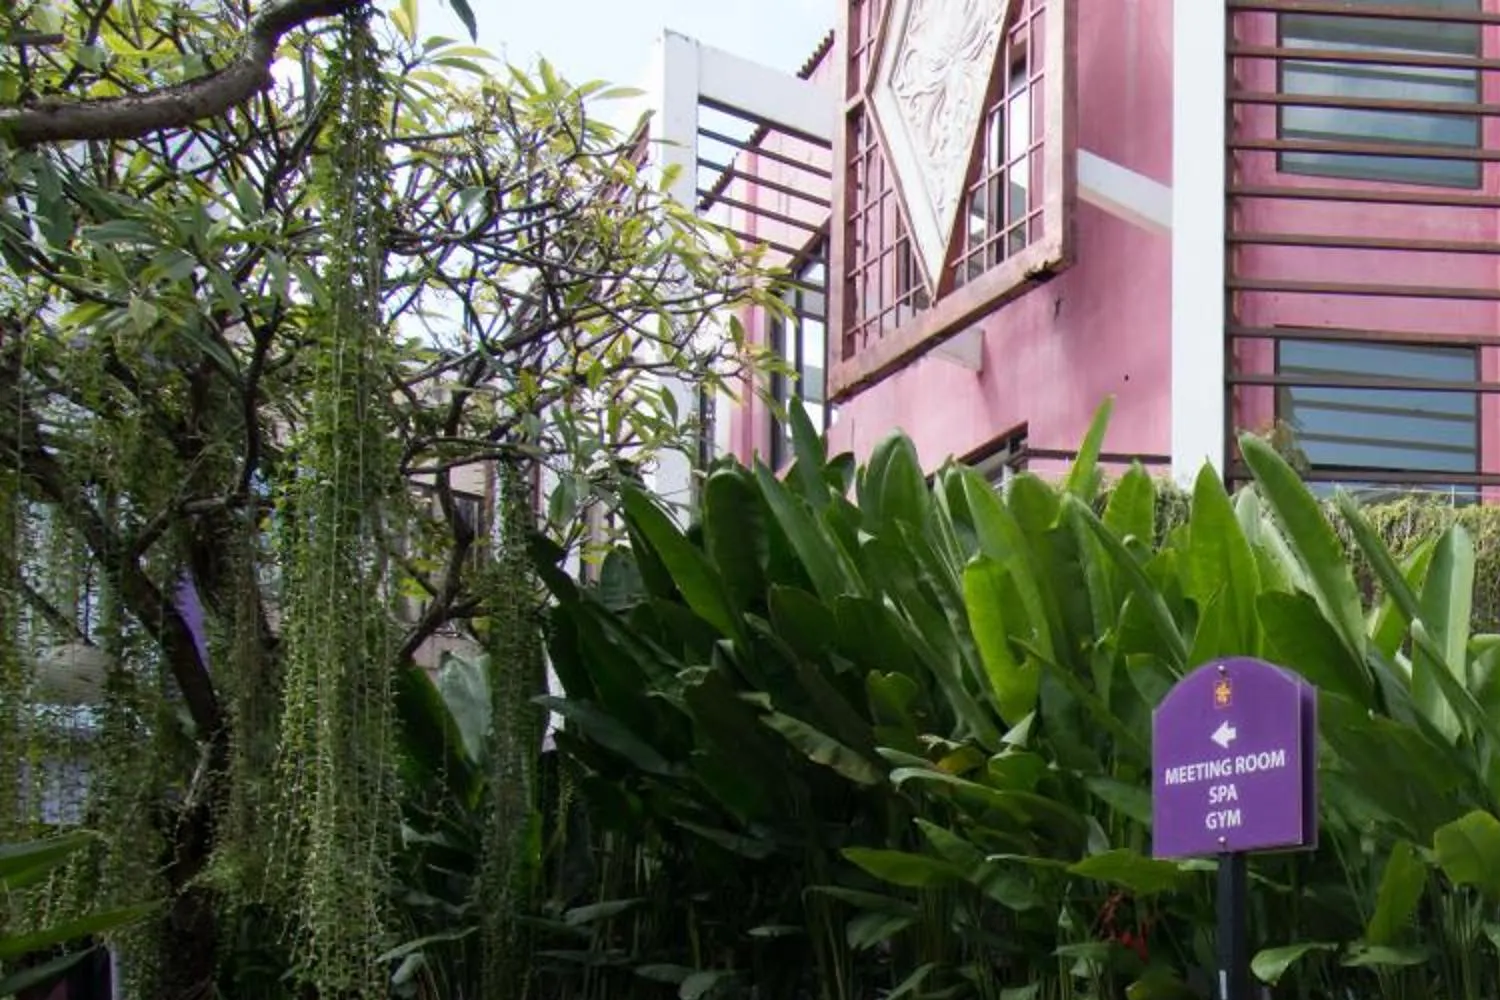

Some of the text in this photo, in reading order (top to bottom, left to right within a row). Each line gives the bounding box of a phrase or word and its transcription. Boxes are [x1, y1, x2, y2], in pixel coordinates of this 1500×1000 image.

[1165, 749, 1286, 785] MEETING ROOM
[1209, 784, 1238, 804] SPA
[1205, 809, 1241, 829] GYM
